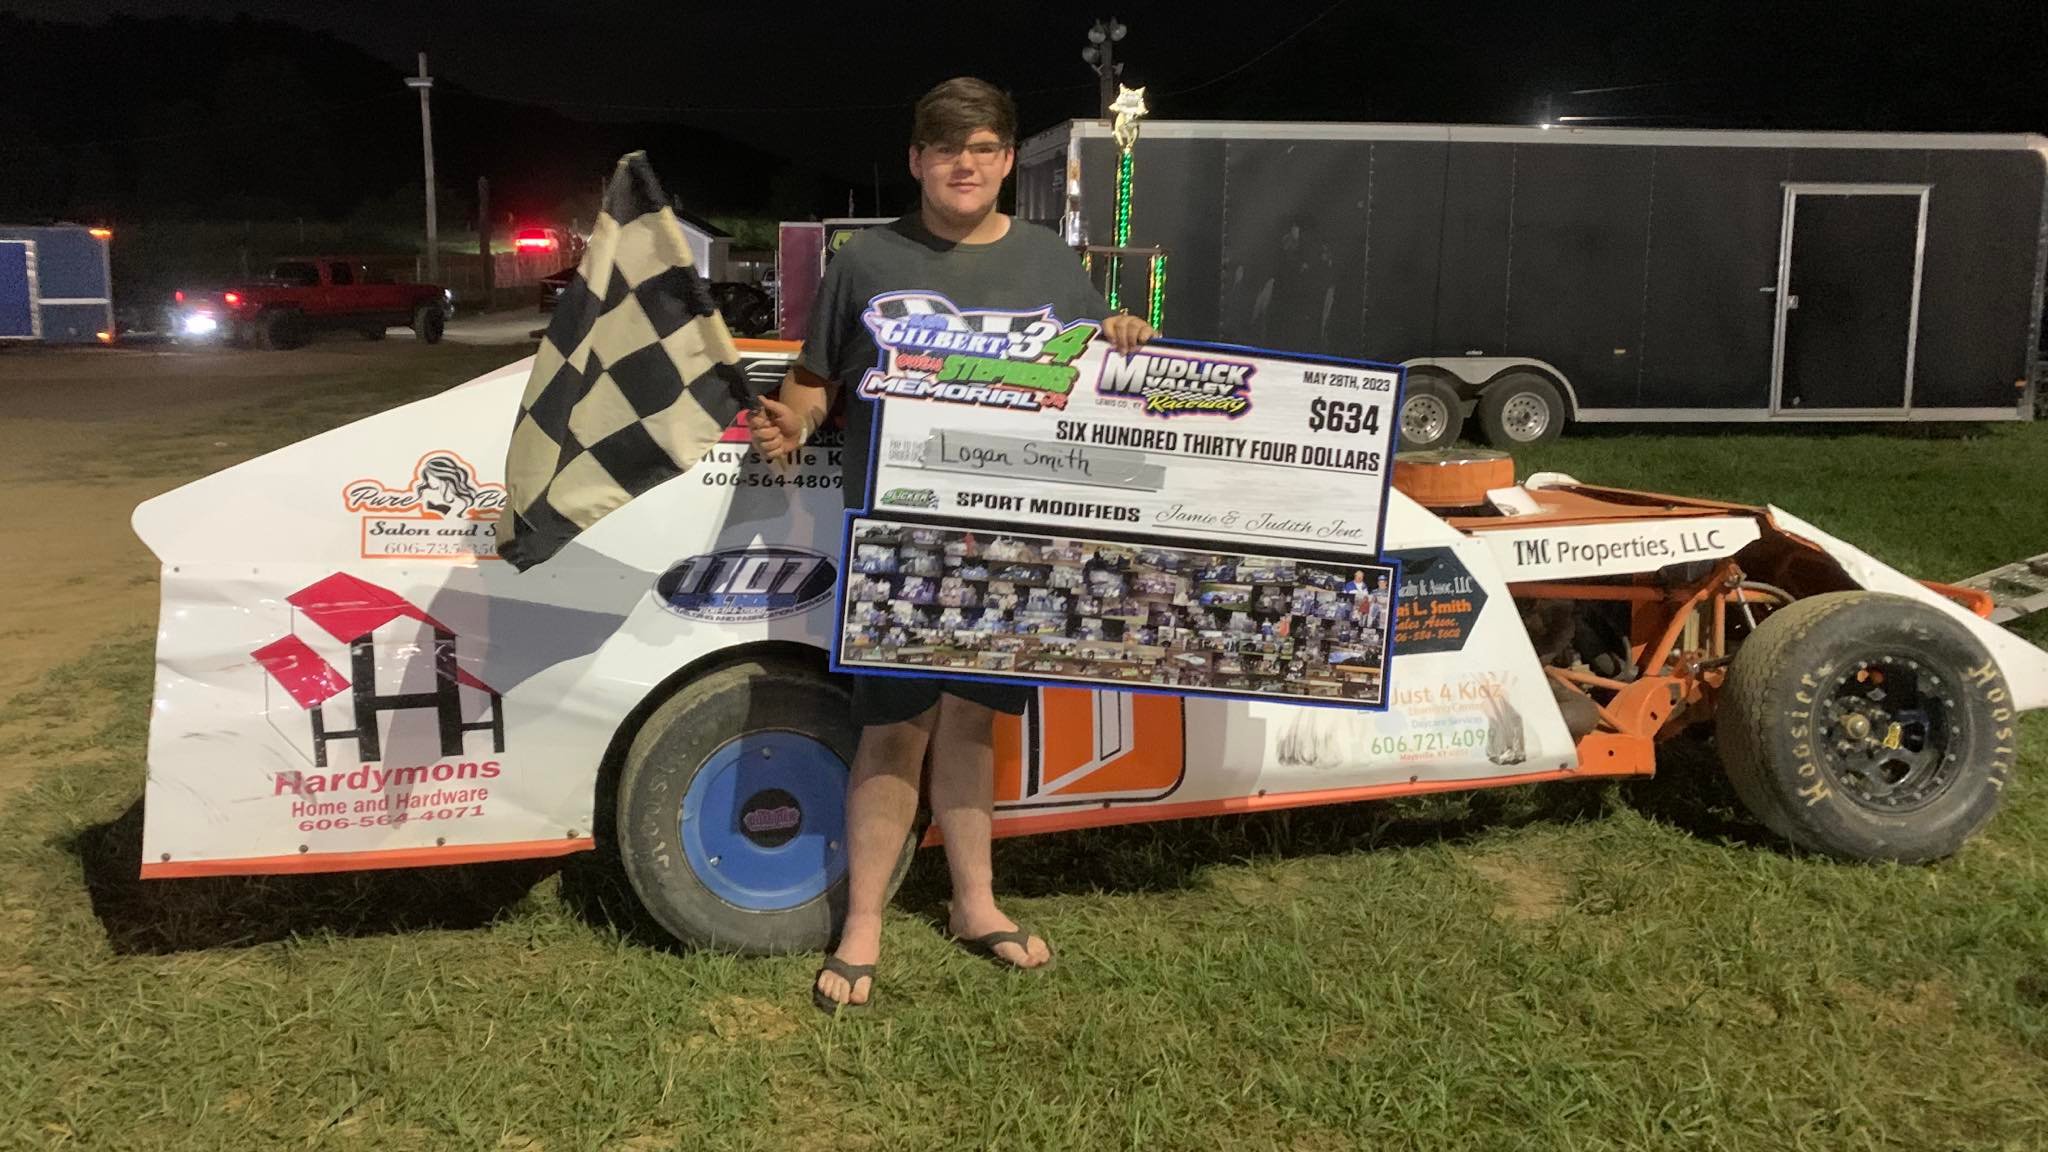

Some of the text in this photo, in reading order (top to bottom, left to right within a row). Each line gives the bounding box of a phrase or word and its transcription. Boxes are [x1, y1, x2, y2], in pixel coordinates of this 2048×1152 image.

[882, 319, 1005, 354] GILBERT
[1101, 351, 1250, 394] MUDLICK
[1145, 376, 1234, 396] VALLEY
[1303, 371, 1391, 392] MAY 28TH, 2023
[866, 376, 1041, 409] MEMORIAL
[1147, 395, 1247, 413] Raceway
[1309, 397, 1380, 436] $634
[939, 431, 1092, 477] Logan Smith
[1056, 420, 1380, 472] SIX HUNDRED THIRTY FOUR DOLLARS
[702, 472, 844, 489] 606-564-4809
[350, 486, 418, 507] Pure
[956, 491, 1141, 522] SPORT MODIFIEDS
[369, 520, 430, 536] Salon
[437, 524, 478, 537] and
[1155, 503, 1363, 539] Jamie & Judith Jent
[1513, 529, 1725, 566] TMC Properties, LLC
[1454, 576, 1473, 594] LLC
[1430, 599, 1473, 615] Smith
[1391, 678, 1503, 706] Just 4 Kidz
[1967, 660, 2014, 792] Hoosier
[274, 761, 501, 795] Hardymons
[292, 787, 489, 818] Home and Hardware
[298, 804, 485, 832] 606-564-4071
